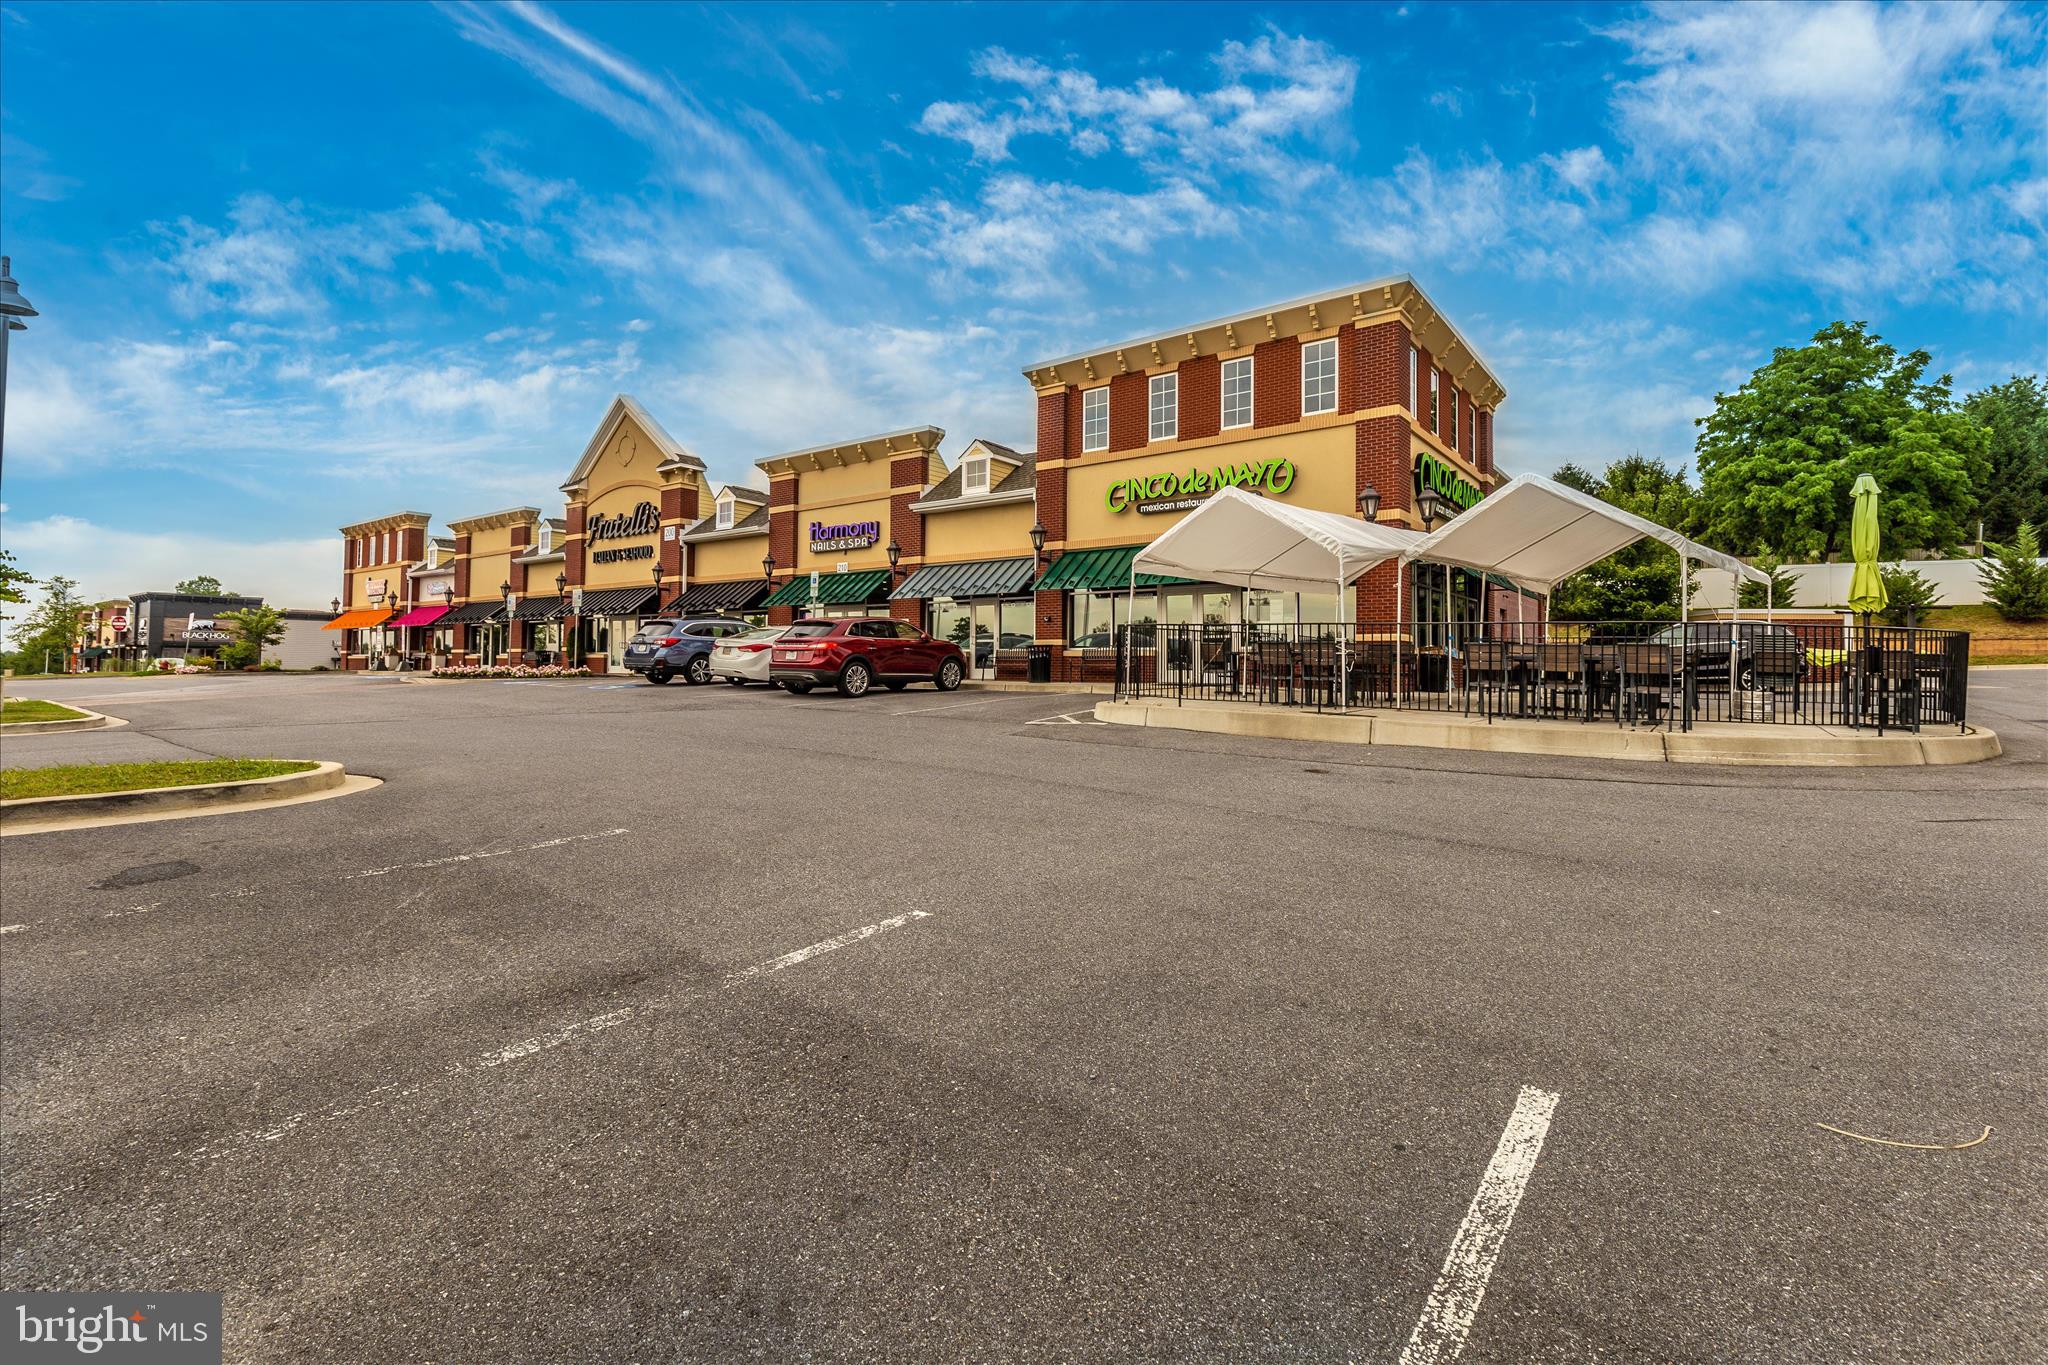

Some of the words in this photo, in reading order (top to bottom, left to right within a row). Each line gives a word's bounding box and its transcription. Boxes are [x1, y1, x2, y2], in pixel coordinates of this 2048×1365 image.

[1105, 472, 1178, 513] CINCO
[1178, 468, 1207, 494] de
[1211, 458, 1296, 494] MAYO
[1140, 501, 1175, 513] mexican
[1176, 498, 1209, 509] restaur
[584, 502, 661, 547] Fratelli's
[809, 521, 879, 543] Harmony
[811, 541, 837, 551] NAILS
[839, 540, 846, 549] &
[848, 537, 868, 548] SPA
[182, 631, 208, 639] BLACK
